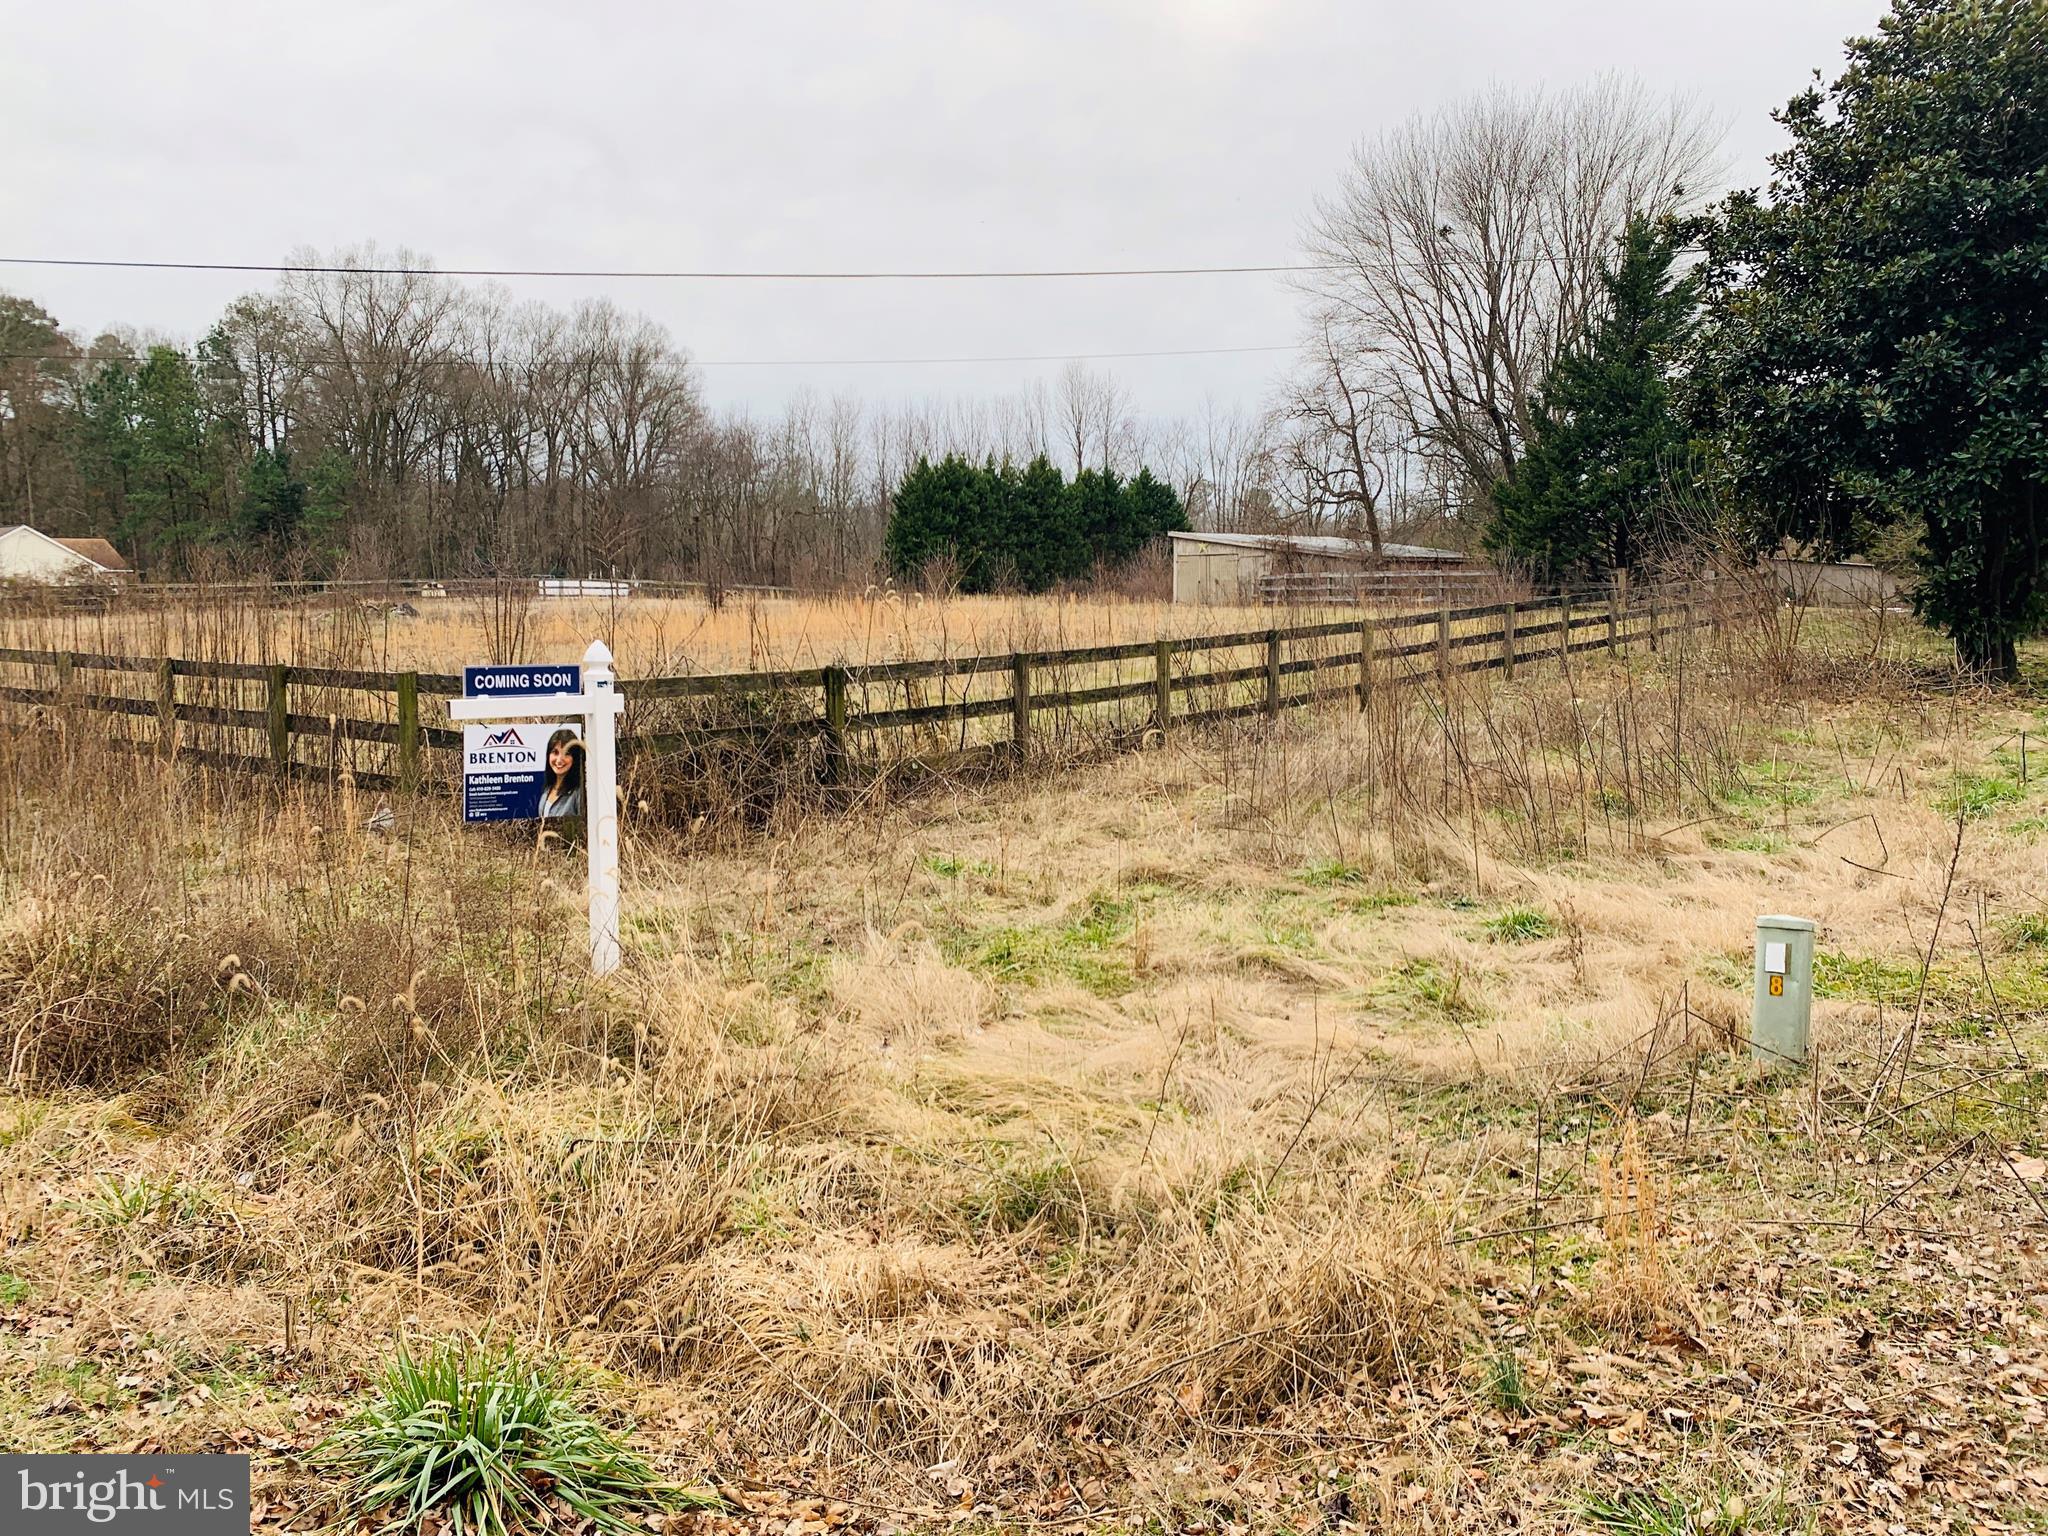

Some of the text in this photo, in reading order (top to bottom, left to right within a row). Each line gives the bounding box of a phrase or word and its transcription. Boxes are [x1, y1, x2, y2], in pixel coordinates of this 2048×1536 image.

[474, 673, 572, 689] COMING SOON
[469, 751, 537, 764] BRENTON
[469, 774, 534, 785] Kathleen Brenton
[1770, 976, 1783, 996] 8
